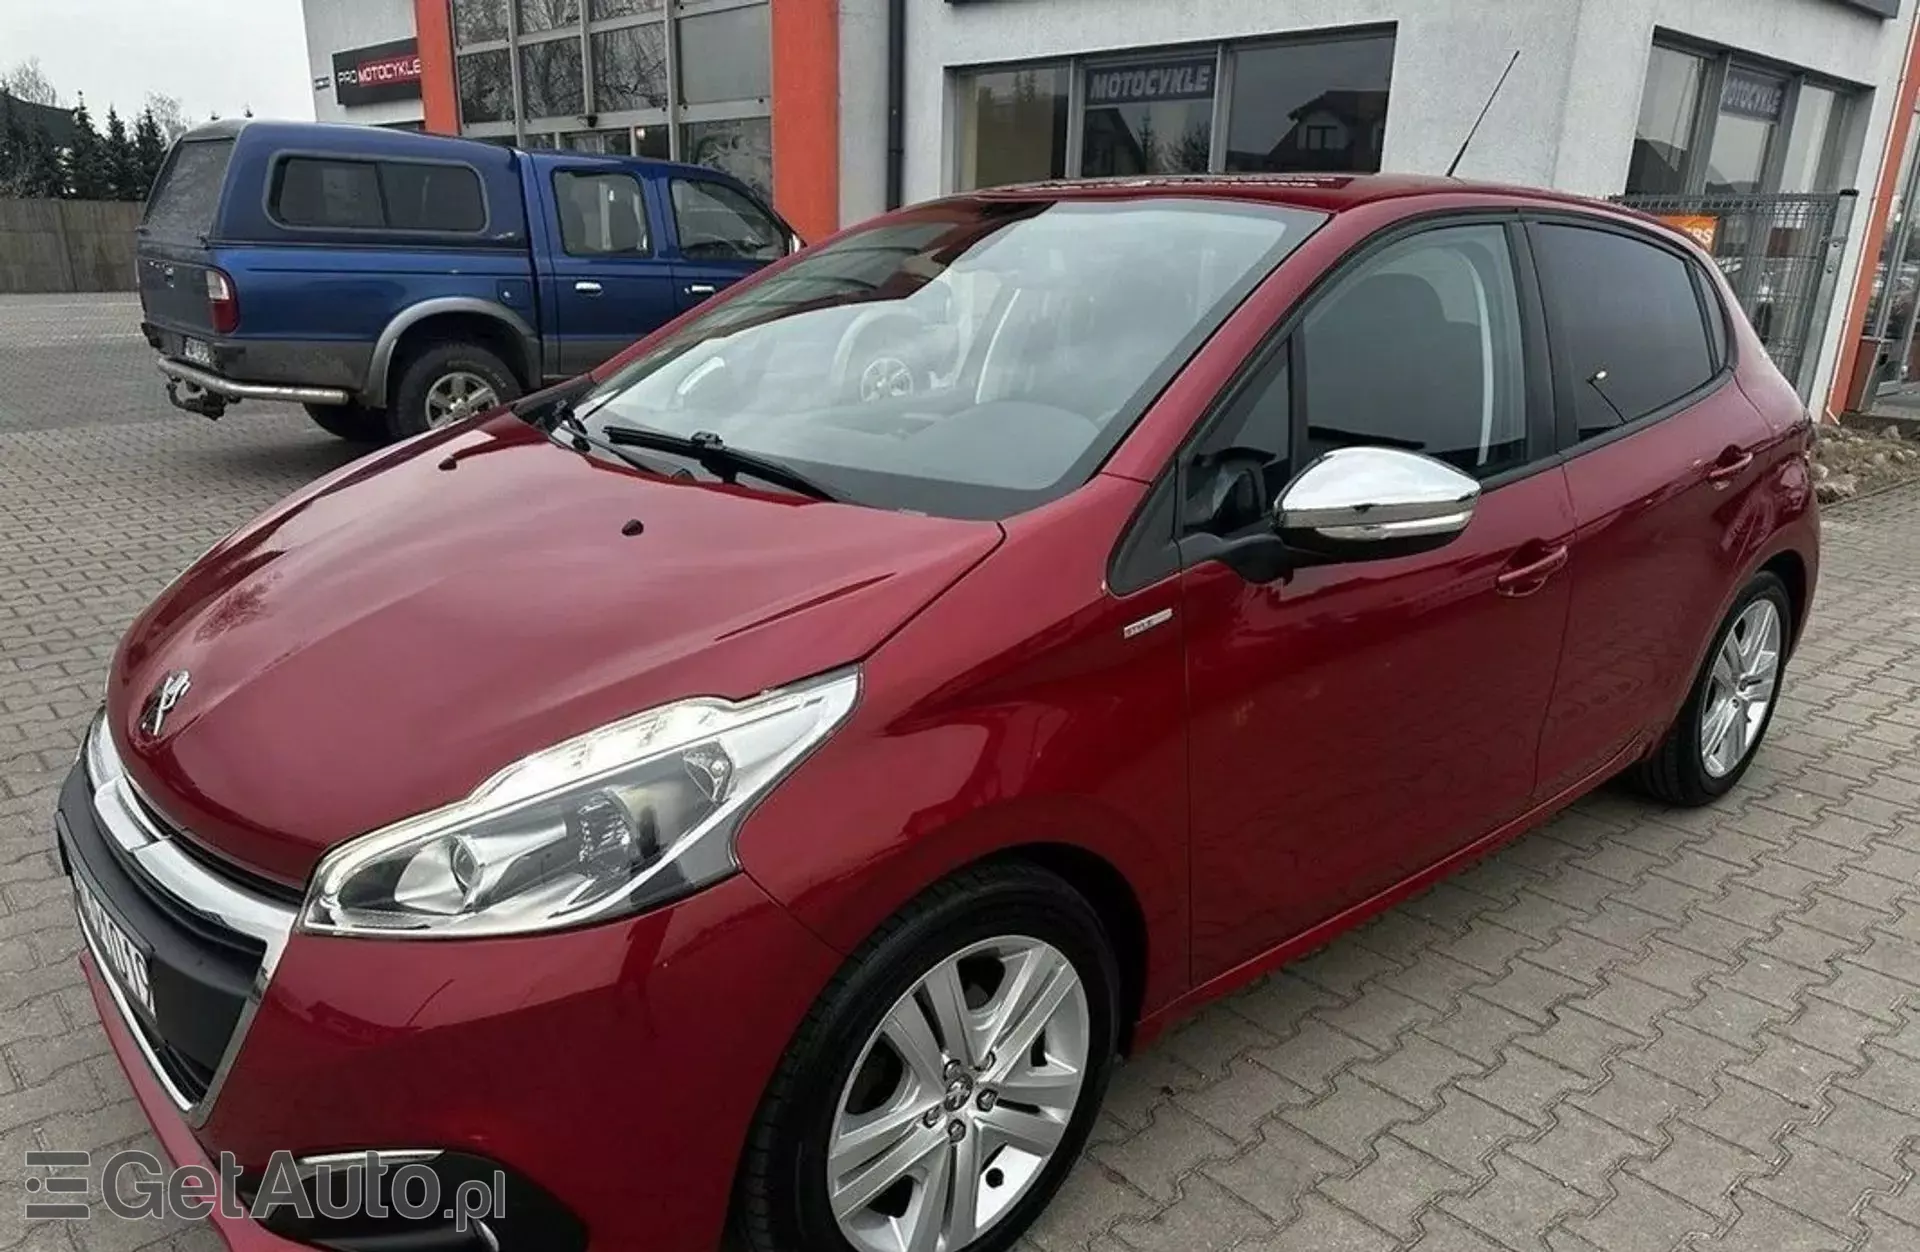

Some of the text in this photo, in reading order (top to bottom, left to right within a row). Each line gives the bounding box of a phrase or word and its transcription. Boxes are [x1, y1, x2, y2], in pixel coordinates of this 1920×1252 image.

[338, 58, 421, 83] PRO MOTOCYKLE
[1091, 65, 1210, 98] MOTOCYKLE
